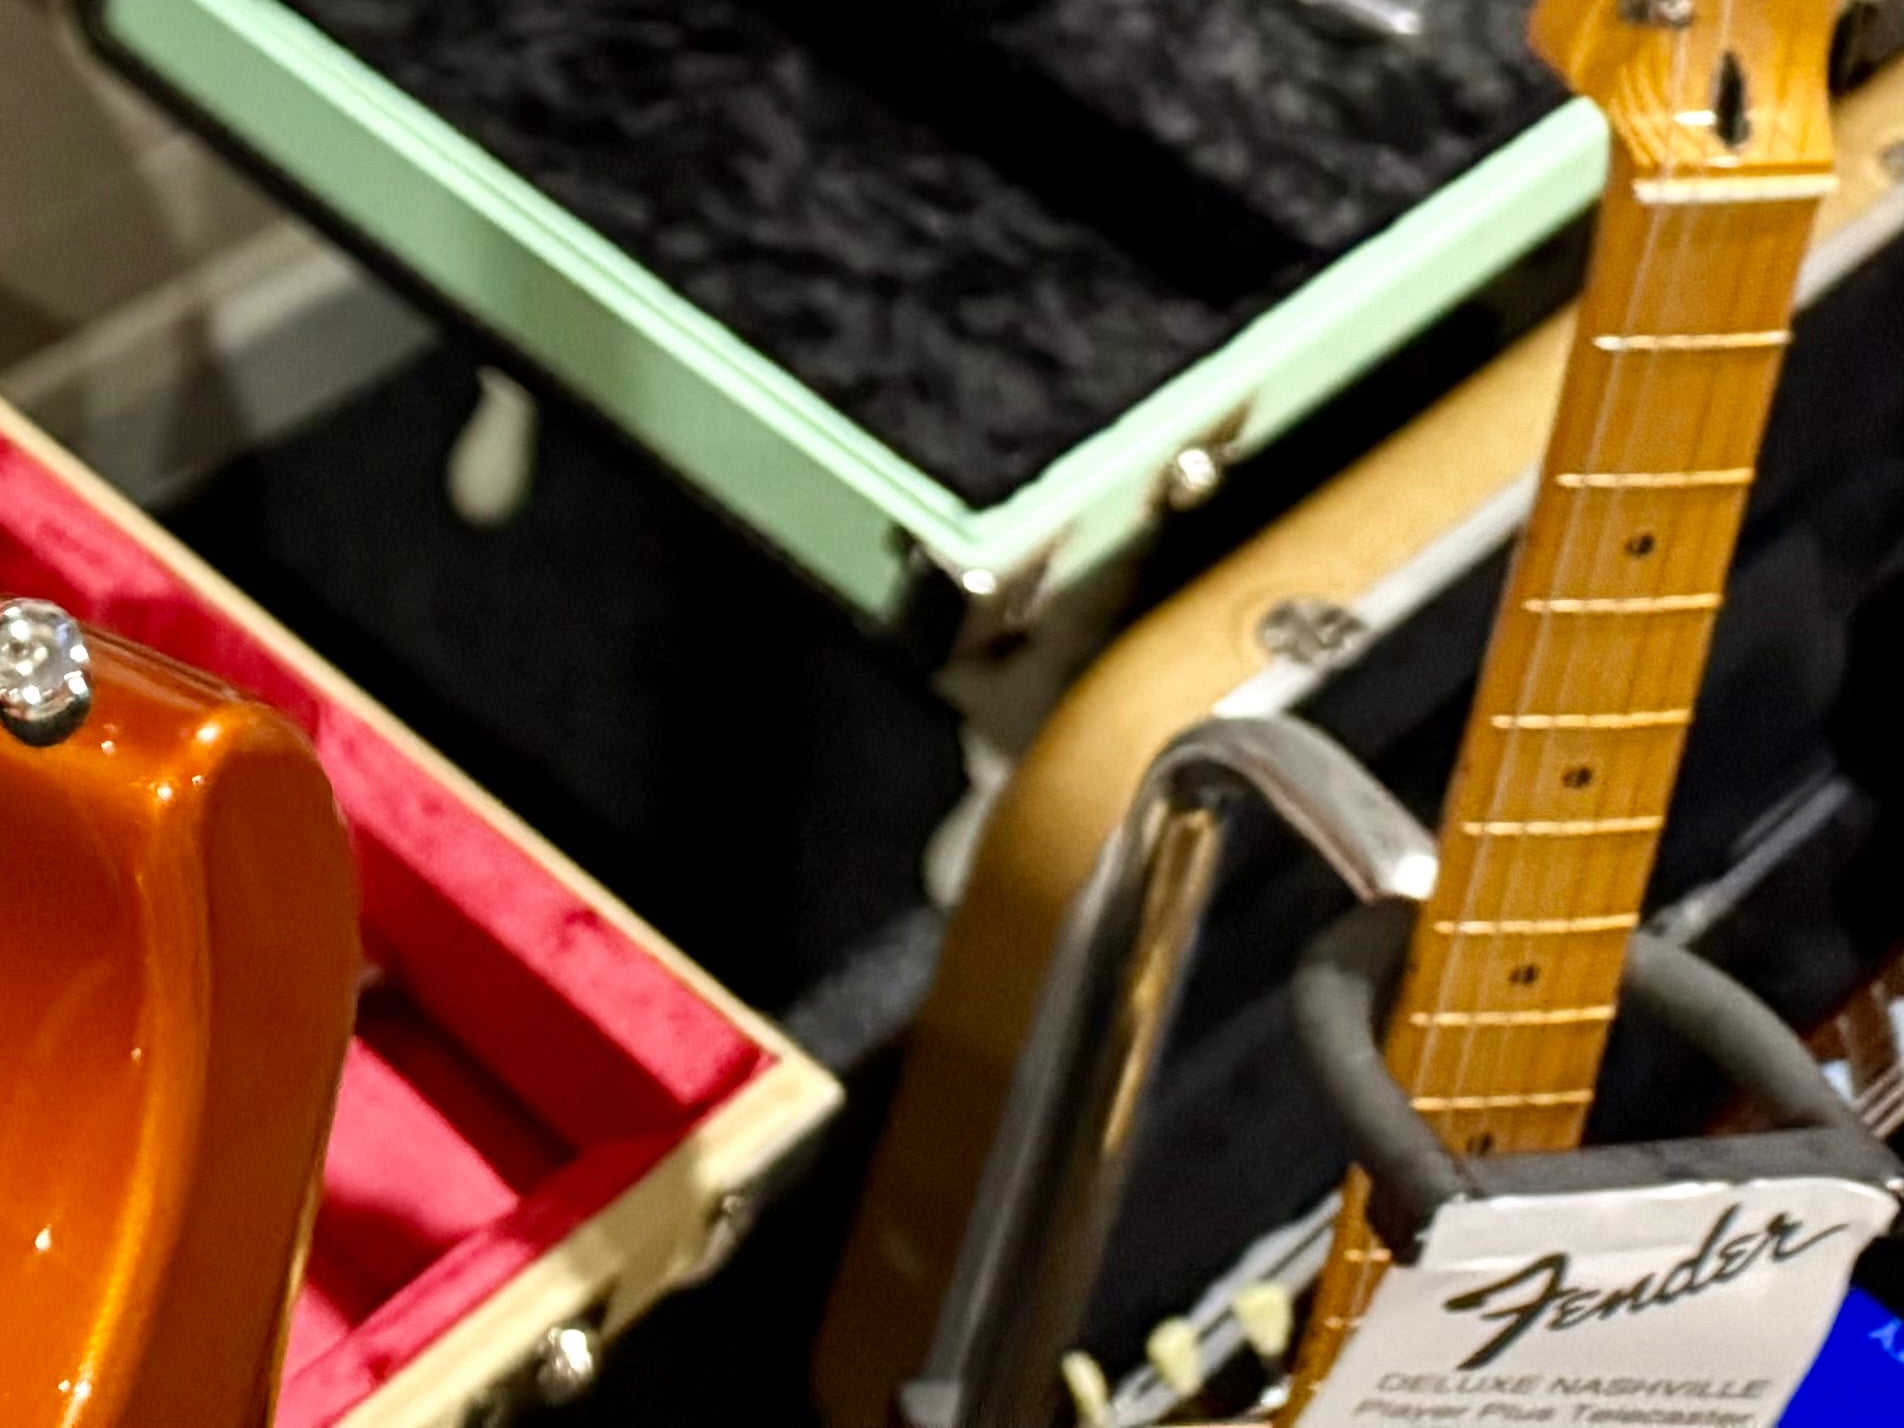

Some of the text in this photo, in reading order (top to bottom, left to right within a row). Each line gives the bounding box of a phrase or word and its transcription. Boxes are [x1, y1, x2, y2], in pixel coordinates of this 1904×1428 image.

[1441, 1201, 1852, 1373] Fender
[1375, 1372, 1772, 1400] DELUXE NASHVILLE
[1350, 1398, 1756, 1426] Player Plus Telecaster
